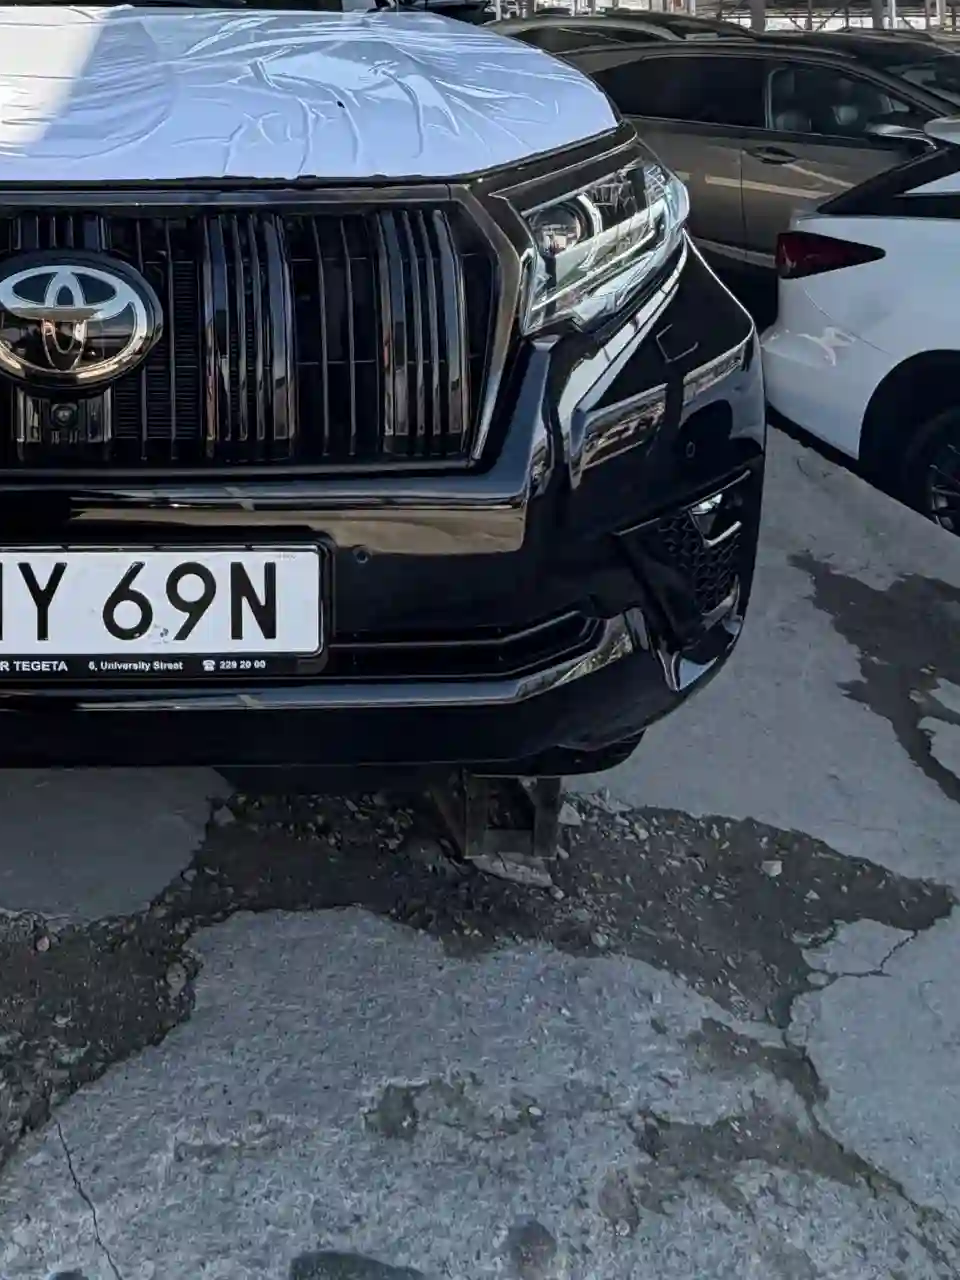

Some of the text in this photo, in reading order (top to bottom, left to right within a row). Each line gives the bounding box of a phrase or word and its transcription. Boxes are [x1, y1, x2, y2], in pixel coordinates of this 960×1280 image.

[102, 561, 277, 641] 69N
[13, 660, 68, 672] TEGETA
[100, 660, 151, 672] University
[153, 660, 183, 671] Street
